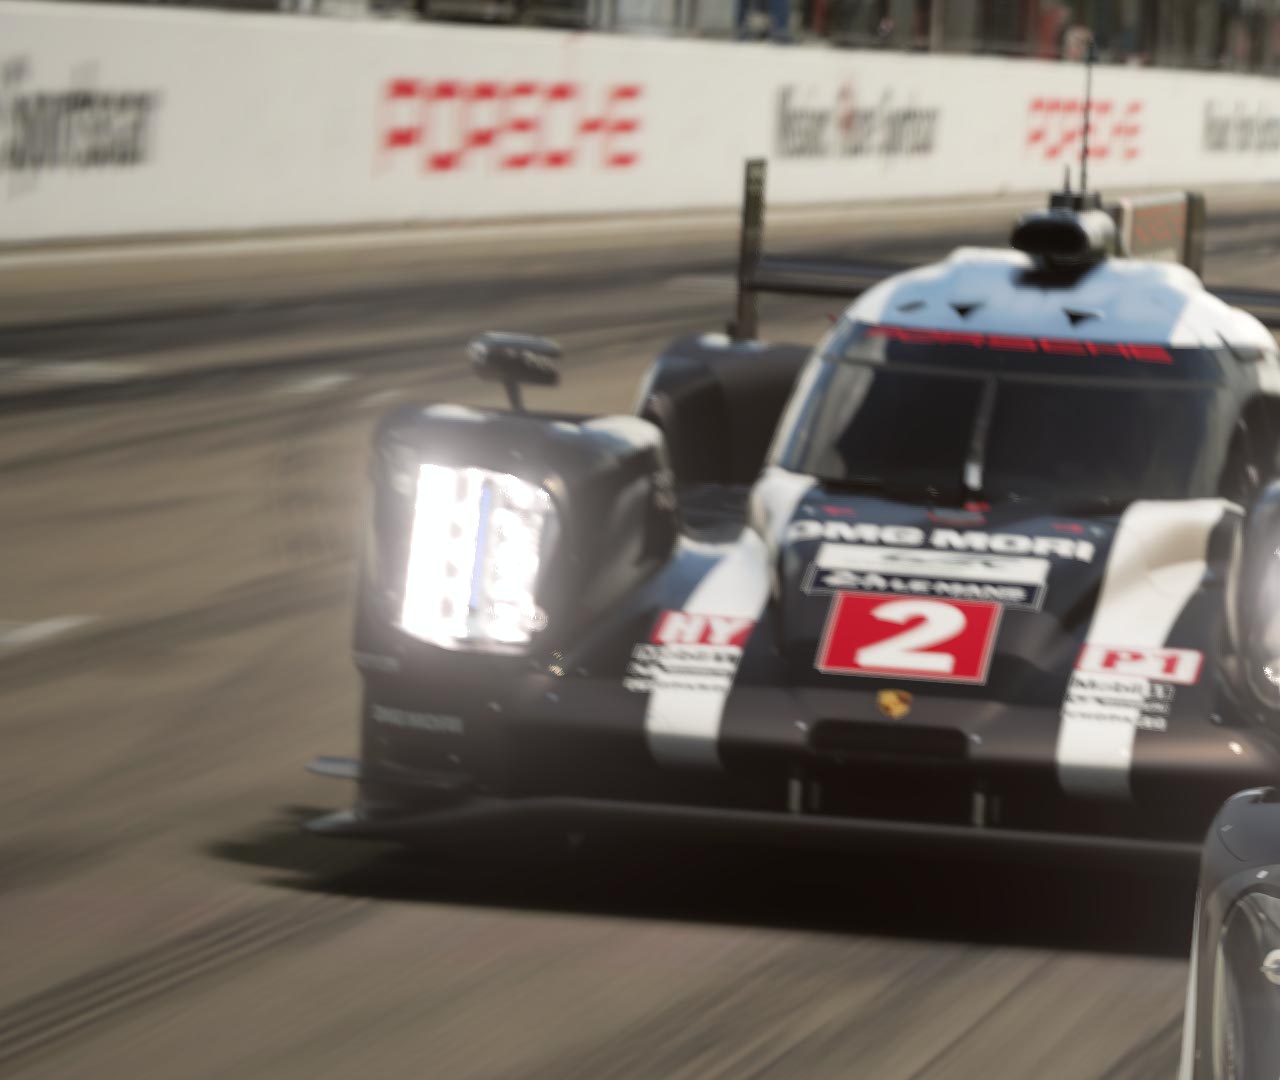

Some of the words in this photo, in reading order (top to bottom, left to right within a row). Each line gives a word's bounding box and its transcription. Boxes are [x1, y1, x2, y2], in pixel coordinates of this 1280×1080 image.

[788, 519, 925, 546] DMG
[931, 528, 1096, 563] MORI
[660, 608, 756, 646] HY
[853, 600, 967, 675] 2
[1102, 650, 1181, 675] P1
